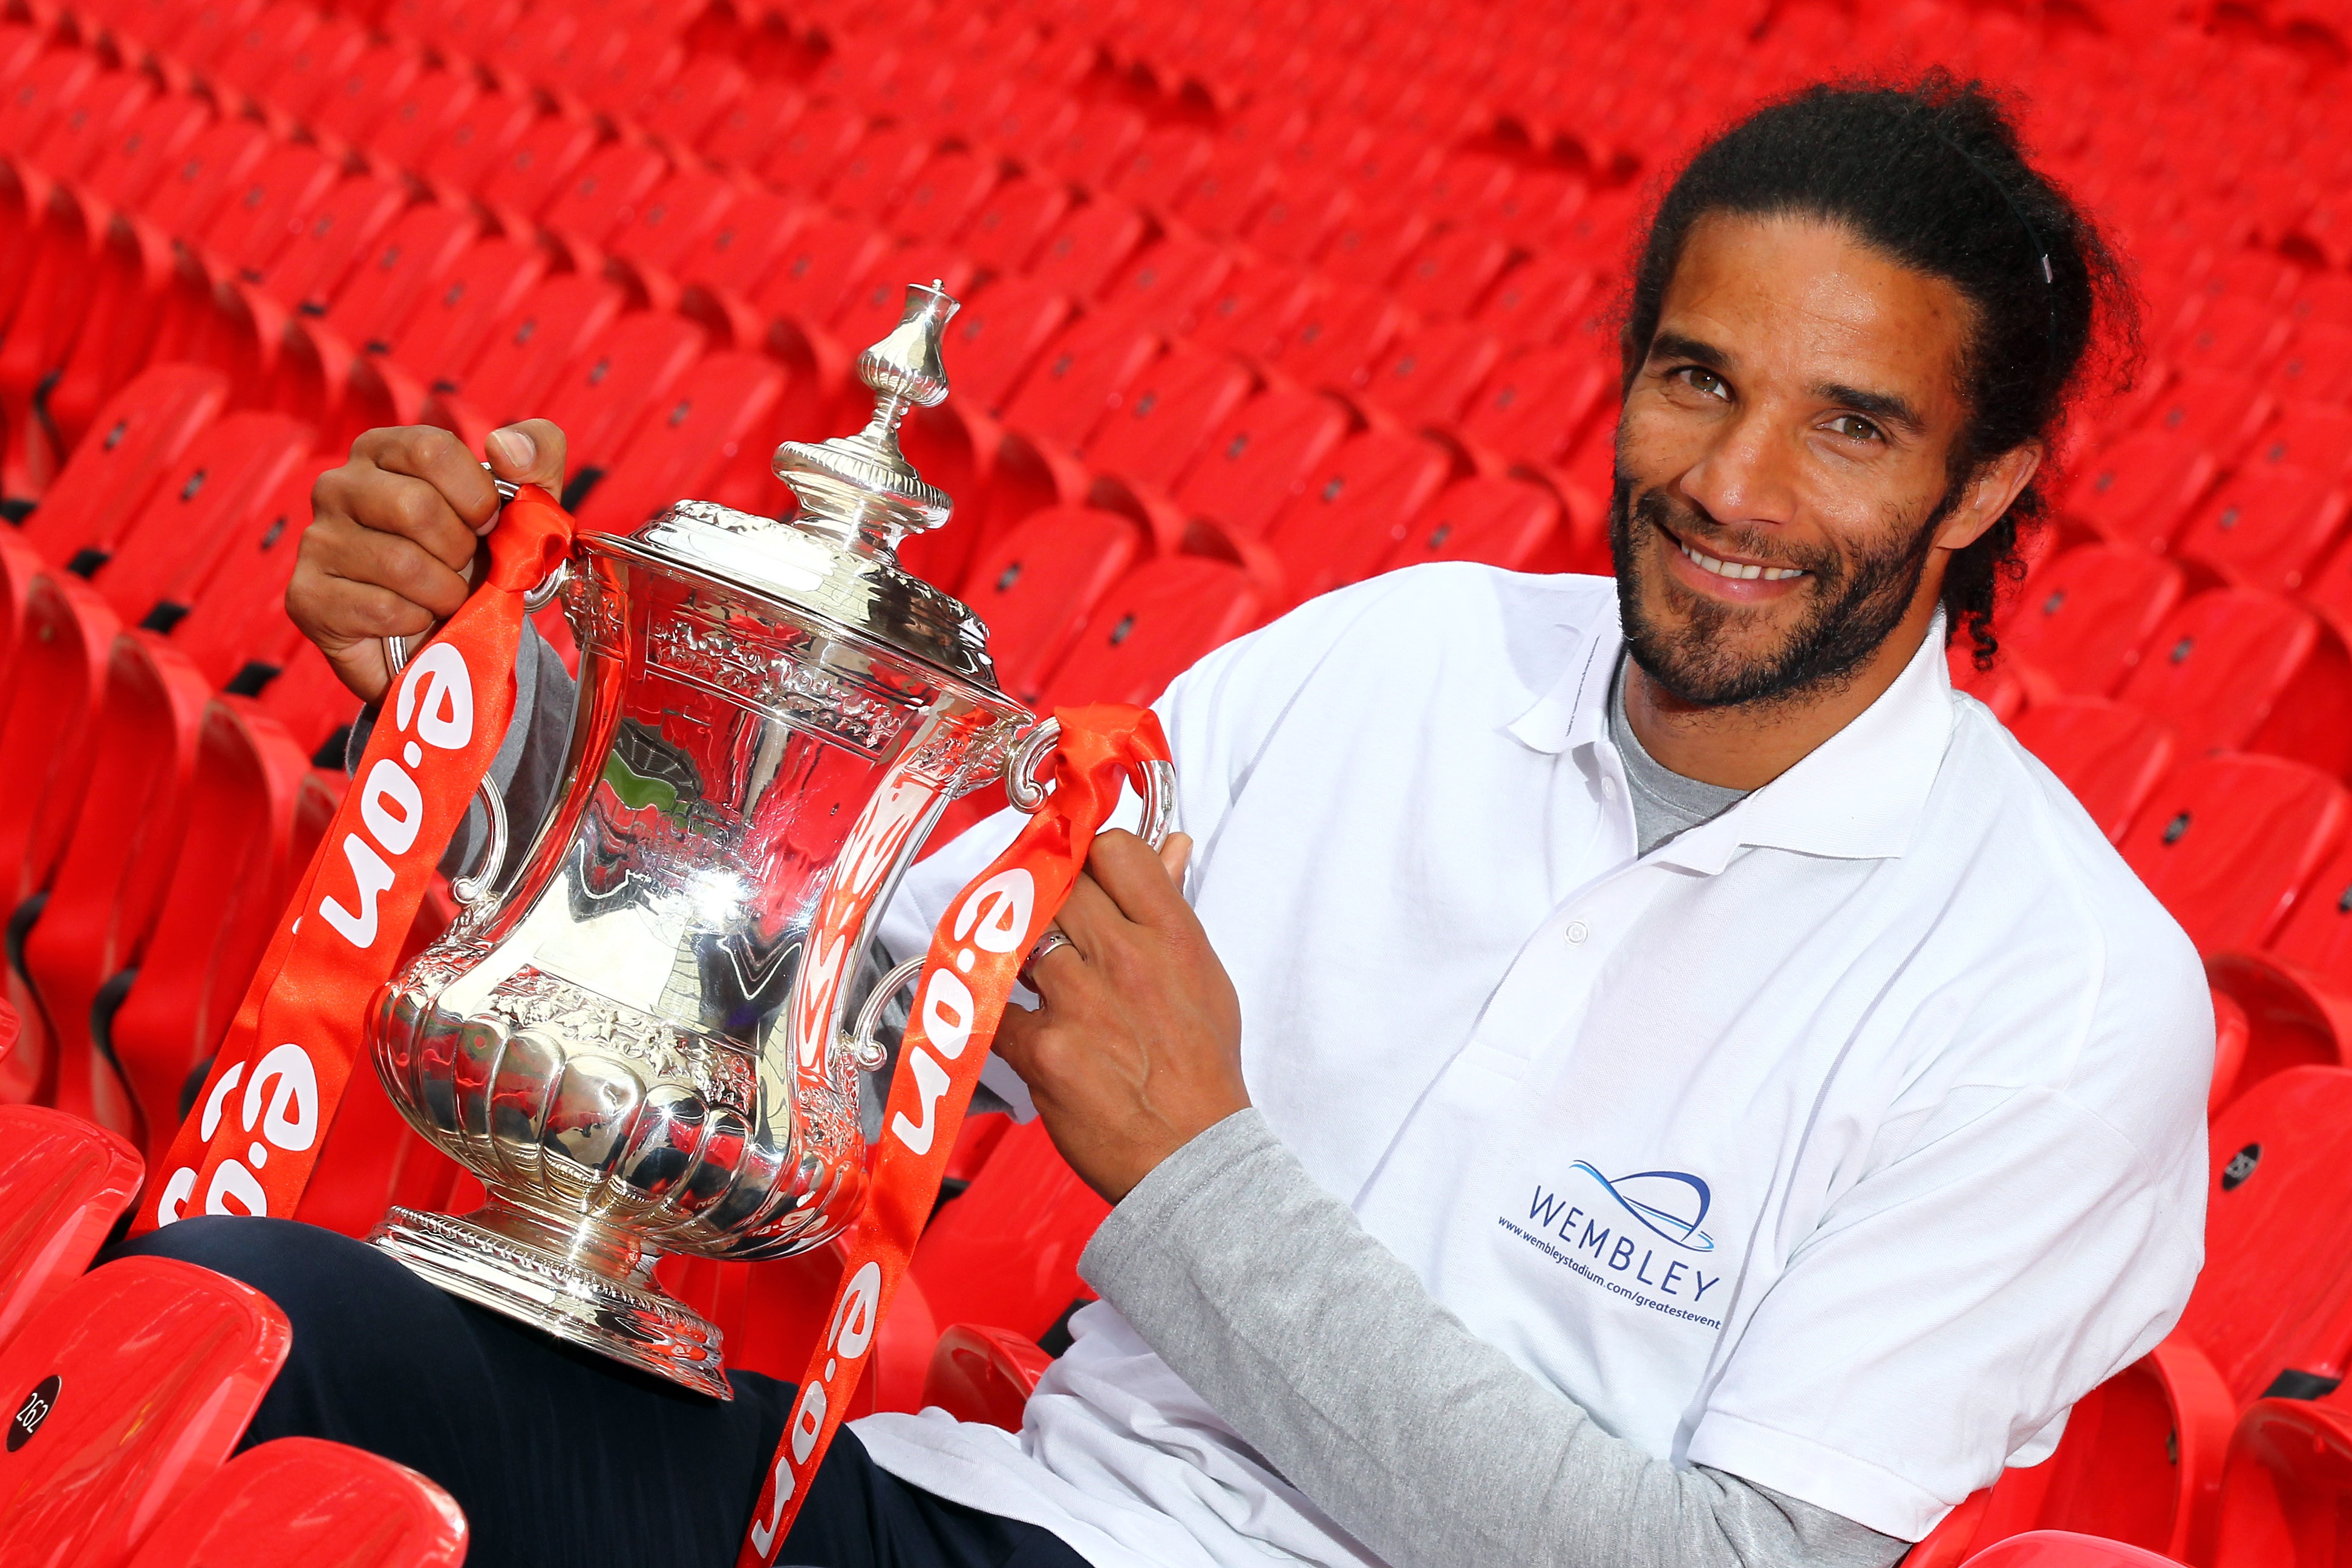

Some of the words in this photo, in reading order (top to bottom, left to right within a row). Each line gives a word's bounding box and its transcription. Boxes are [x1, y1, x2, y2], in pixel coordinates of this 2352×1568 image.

[319, 642, 474, 949] e.on
[892, 867, 1035, 1155] e.on
[1498, 1216, 1722, 1330] www.wembleystadium.com/greatestevent
[1529, 1185, 1720, 1302] WEMBLEY
[16, 1392, 48, 1434] 262
[751, 1261, 881, 1559] e.on
